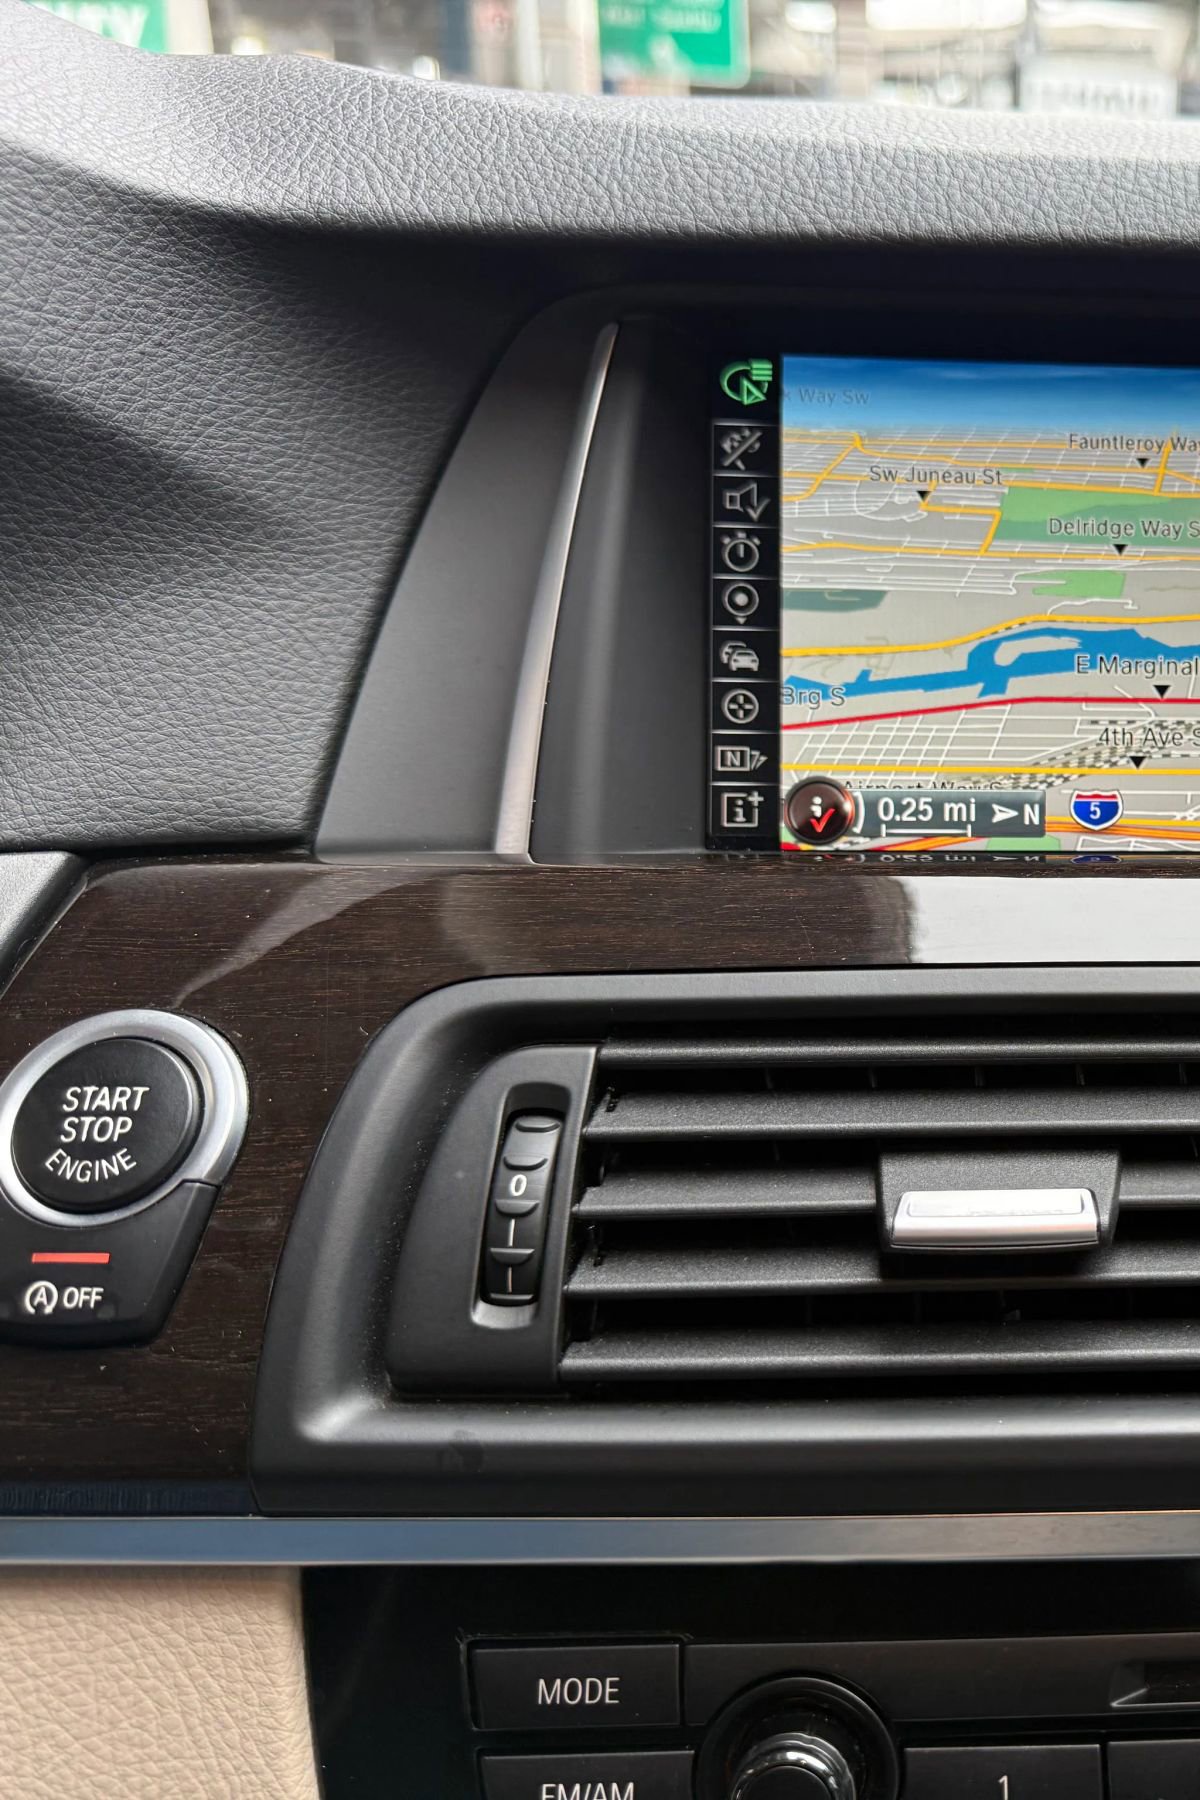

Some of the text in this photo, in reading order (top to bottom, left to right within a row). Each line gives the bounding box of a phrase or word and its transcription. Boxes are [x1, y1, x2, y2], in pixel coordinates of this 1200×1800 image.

[799, 387, 837, 408] Way
[842, 388, 870, 405] Sw
[1068, 433, 1165, 452] Fauntleroy
[869, 465, 1002, 485] Sw Juneau St
[1049, 517, 1135, 538] Delridge
[1141, 519, 1182, 540] Way
[1076, 655, 1090, 674] E
[1099, 655, 1198, 678] Marginal
[781, 686, 846, 709] Brg S
[1098, 727, 1133, 747] 4th
[1143, 728, 1184, 747] Ave
[877, 796, 1040, 826] 0.25 mi N
[1089, 801, 1101, 820] 5
[62, 1086, 149, 1112] START
[60, 1116, 132, 1143] STOP
[45, 1148, 137, 1183] ENGINE
[63, 1286, 104, 1309] OFF
[537, 1676, 621, 1706] MODE
[541, 1781, 635, 1800] FM/AM
[997, 1774, 1011, 1800] 1
